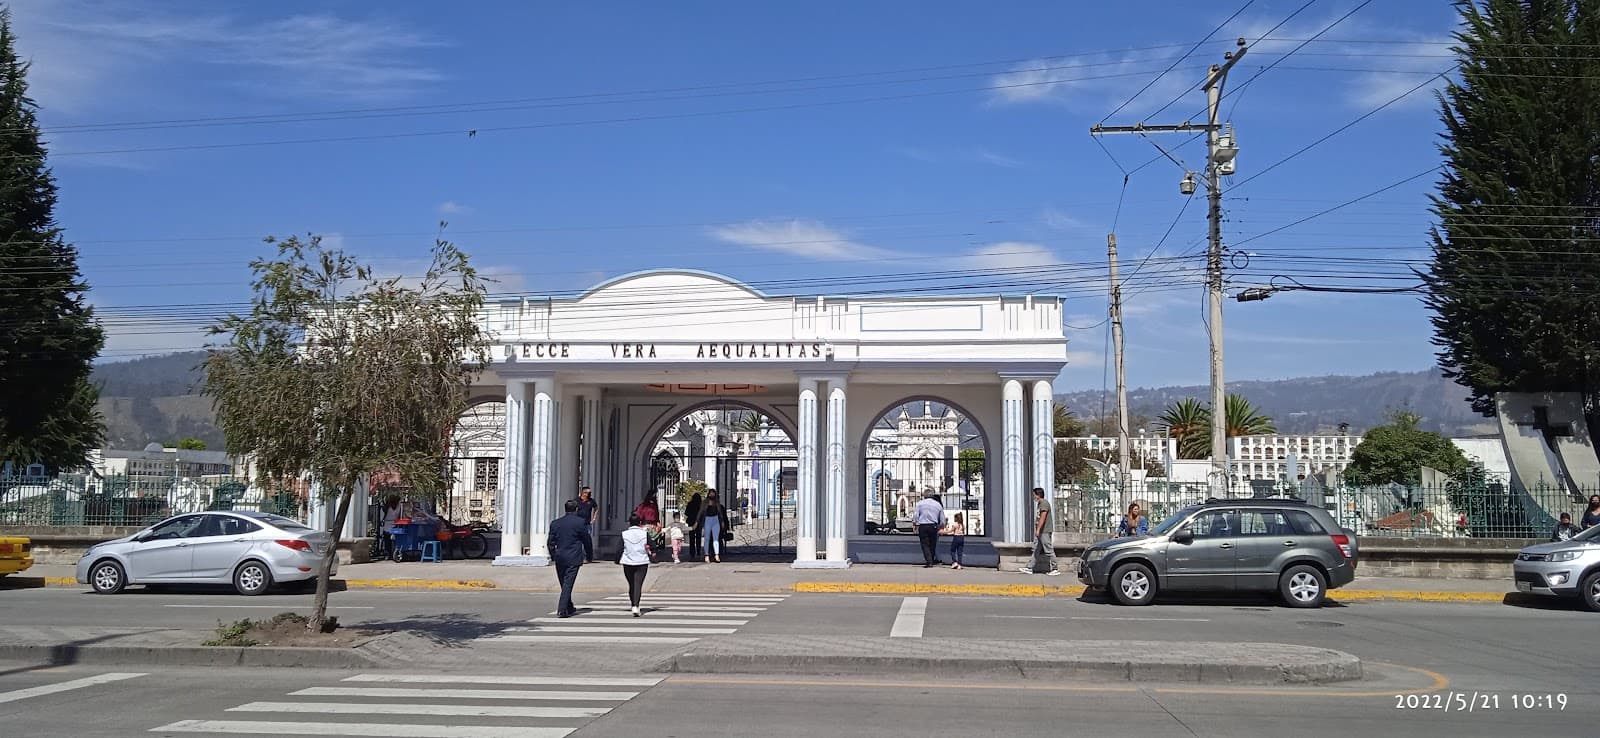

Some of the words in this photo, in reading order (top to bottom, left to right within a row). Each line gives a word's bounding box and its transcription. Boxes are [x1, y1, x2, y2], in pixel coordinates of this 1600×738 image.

[522, 343, 571, 359] ECCE
[610, 343, 658, 359] VERA
[696, 342, 822, 359] AEQUALITAS
